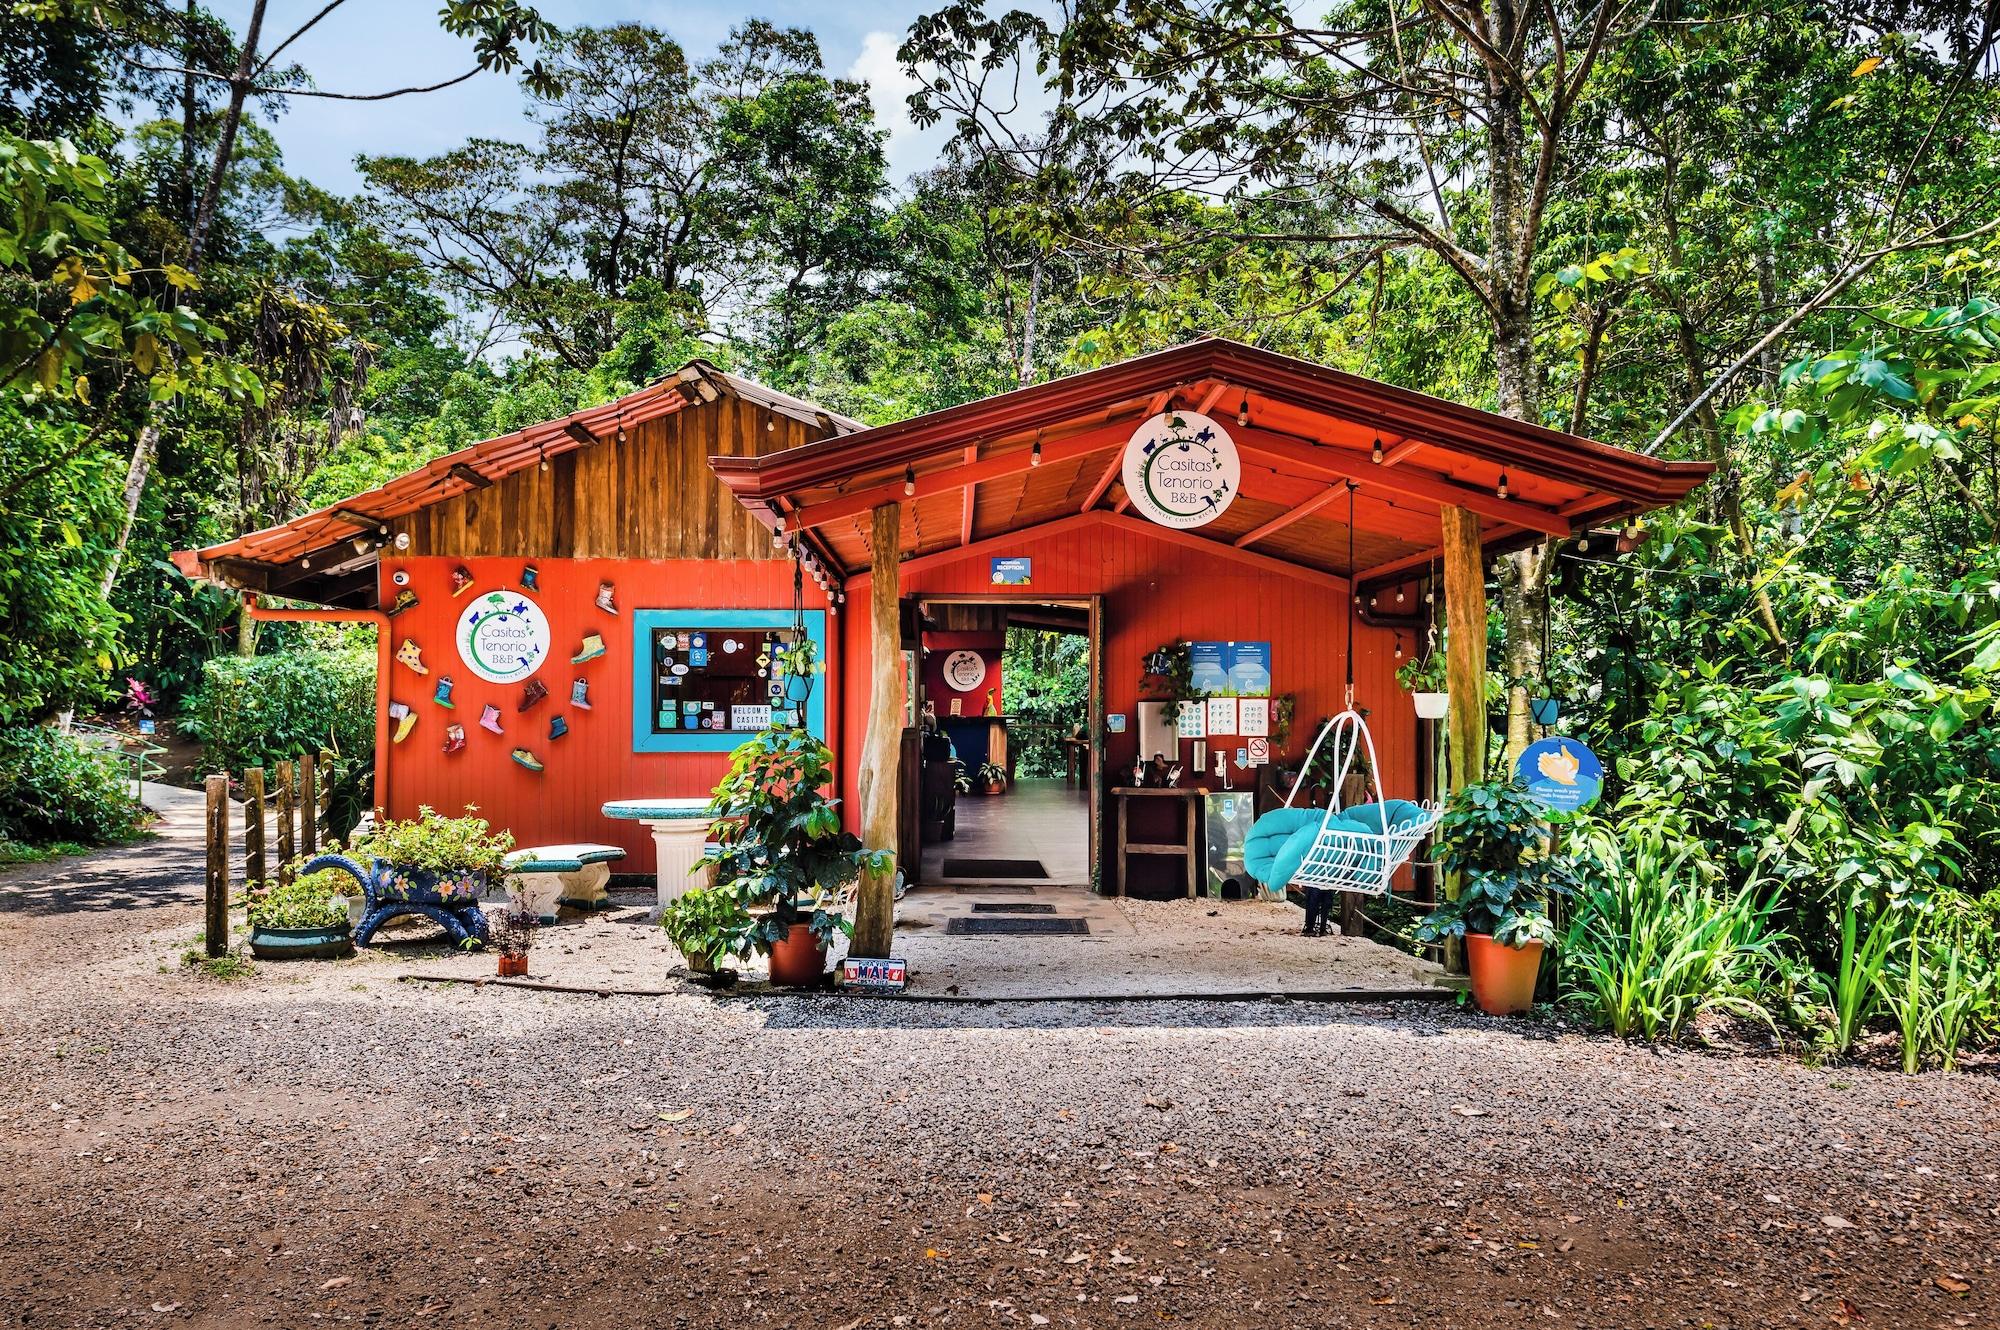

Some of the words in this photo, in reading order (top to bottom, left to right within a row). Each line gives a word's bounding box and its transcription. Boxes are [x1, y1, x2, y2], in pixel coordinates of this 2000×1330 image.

[1157, 454, 1212, 472] Casitas
[1157, 472, 1213, 490] Tenorio
[1170, 491, 1197, 504] B&B
[481, 624, 527, 639] Casitas
[480, 638, 527, 652] Tenorio
[492, 654, 514, 664] B&B
[736, 716, 768, 724] CASITAS
[1552, 792, 1579, 800] frequently
[858, 966, 889, 979] MAE
